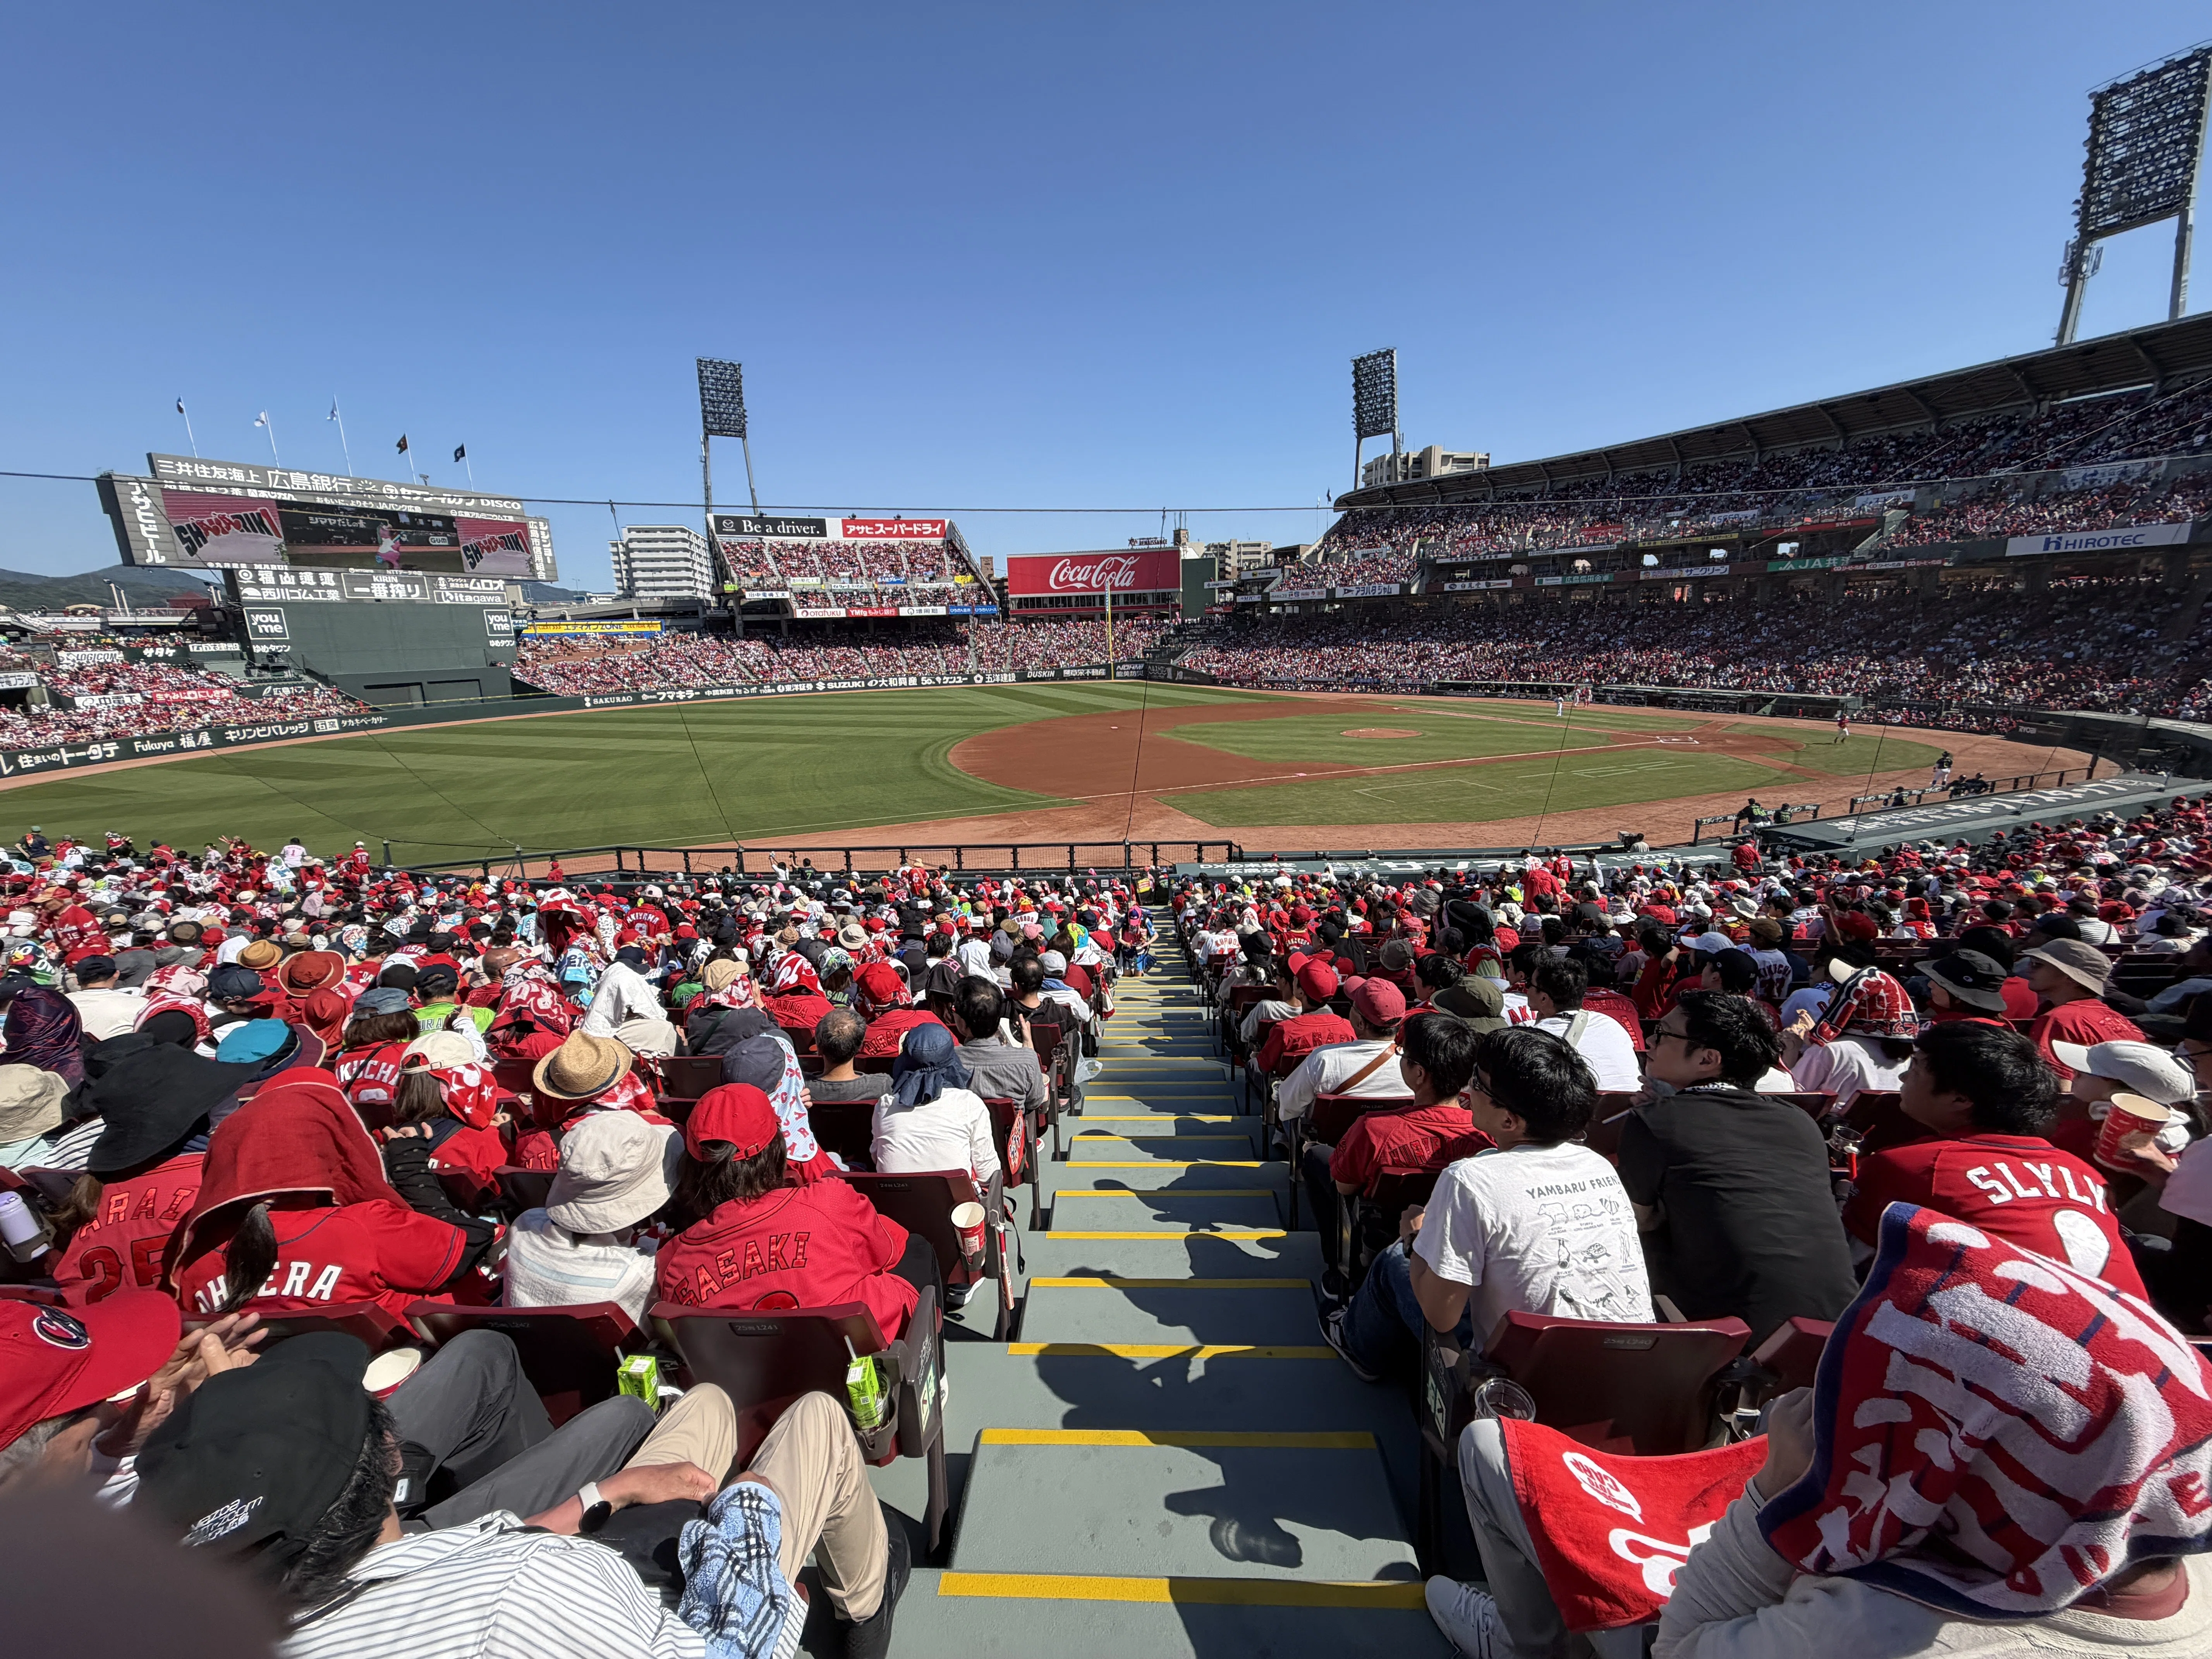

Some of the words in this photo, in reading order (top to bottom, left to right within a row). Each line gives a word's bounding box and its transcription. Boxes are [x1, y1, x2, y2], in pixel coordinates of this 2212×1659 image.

[158, 459, 262, 484] 三井住友海上
[267, 470, 353, 496] 広島銀行
[480, 498, 521, 509] DISCO
[128, 482, 166, 563] アサヒビール
[309, 517, 366, 528] シマヤだしの素
[742, 520, 761, 532] Be
[765, 525, 773, 533] a
[777, 521, 820, 534] driver.
[846, 523, 941, 534] アサヒスーパードライ
[2064, 534, 2146, 550] HIROTEC
[529, 521, 546, 579] 広島市信用組合
[1049, 556, 1140, 589] Coca-Cola
[1685, 567, 1728, 576] サニクリーン
[258, 570, 335, 586] 福山通運
[469, 579, 504, 591] ムロオ
[1355, 585, 1392, 596] アヲハタジャム
[261, 588, 340, 601] 西川ゴム工業
[441, 592, 501, 603] Kitagawa
[251, 614, 279, 625] you
[488, 614, 507, 624] you
[258, 624, 283, 633] me
[143, 647, 176, 657] サタケ
[252, 644, 290, 653] ゆめタウン
[943, 676, 968, 684] ケンユー
[985, 672, 1016, 684] 五洋建設
[1027, 670, 1055, 678] DUSKIN
[785, 683, 813, 692] 東洋証券
[879, 677, 917, 687] 大和興産
[273, 686, 306, 696] 広島ガス
[657, 691, 700, 701] フマキラー
[593, 696, 633, 705] SAKURAO
[342, 717, 388, 727] タカキベーカリー
[225, 722, 309, 742] キリンビバレッジ
[133, 740, 174, 753] Fukuya
[179, 732, 213, 749] 福屋
[17, 742, 119, 769] 住まいのトータテ
[627, 911, 659, 925] AKIYAMA
[1526, 1180, 1587, 1200] YAMBARU
[674, 1231, 811, 1307] SASAKI
[194, 1261, 344, 1313] OHERA
[1570, 1457, 1620, 1492] CARP
